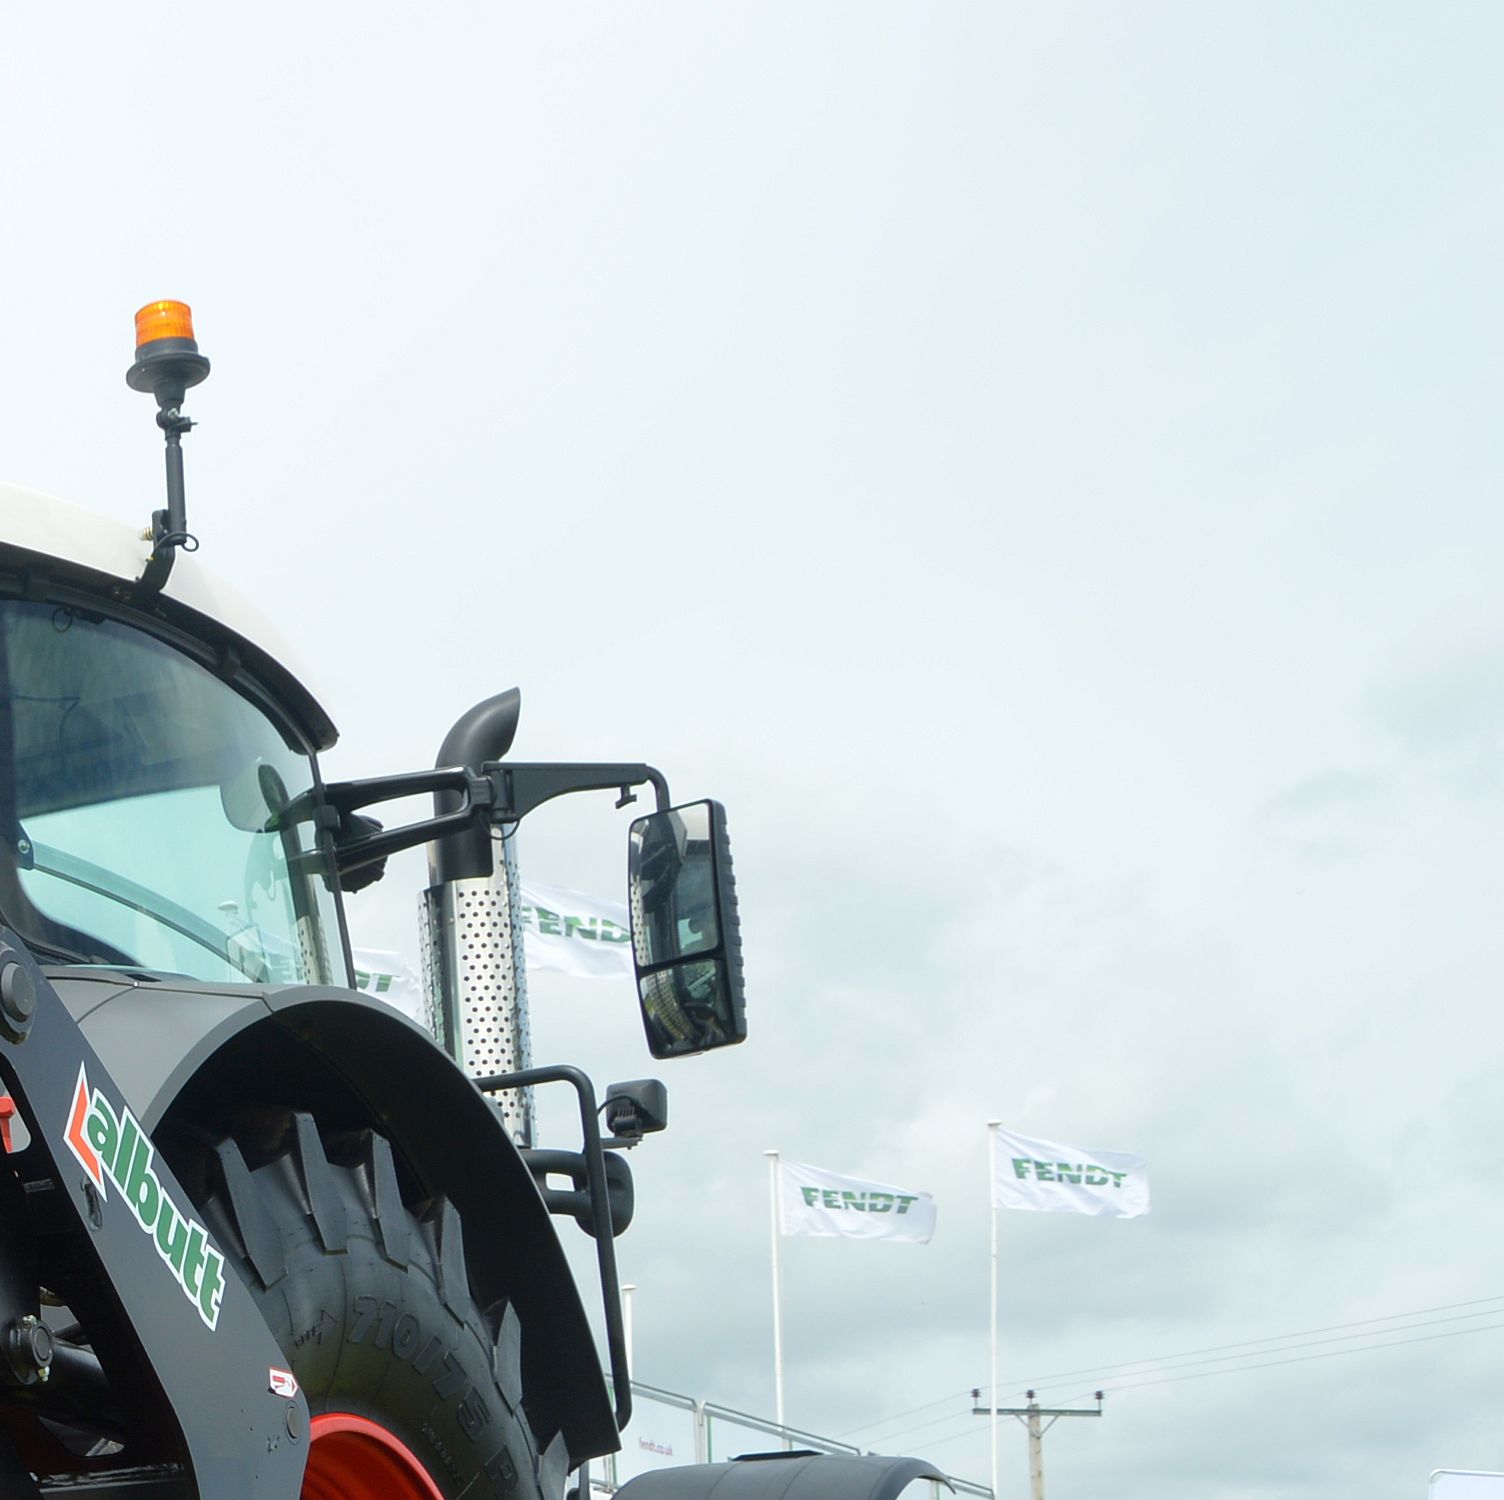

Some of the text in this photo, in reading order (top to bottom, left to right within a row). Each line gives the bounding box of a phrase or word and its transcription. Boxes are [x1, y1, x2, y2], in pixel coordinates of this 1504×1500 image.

[85, 1090, 224, 1329] albutt
[799, 1186, 919, 1215] FENDT
[1010, 1157, 1128, 1188] FENDT
[347, 1295, 490, 1443] 710/75
